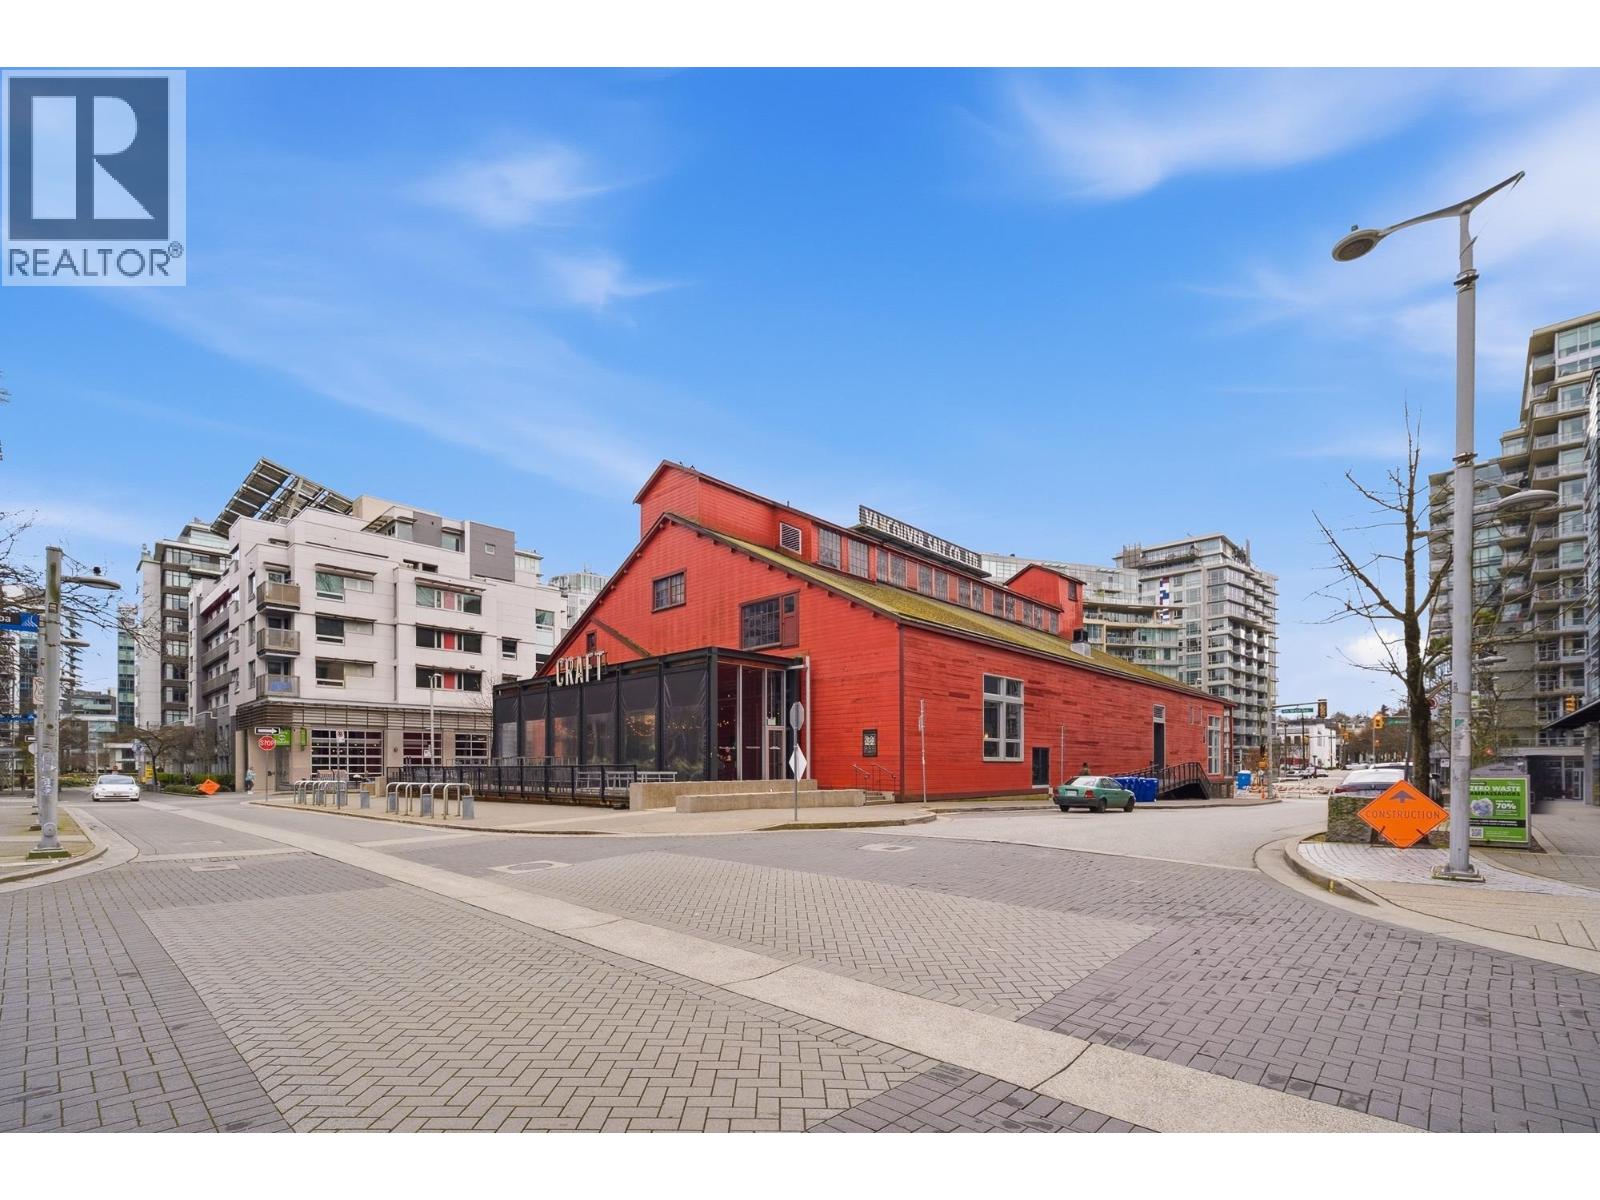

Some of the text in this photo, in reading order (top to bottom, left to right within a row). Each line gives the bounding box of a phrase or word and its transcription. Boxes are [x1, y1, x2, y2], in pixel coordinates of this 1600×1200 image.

[864, 509, 925, 546] VANCOUVER
[927, 535, 946, 555] SALT
[556, 650, 605, 687] CRAFT
[259, 739, 275, 747] STOP
[1495, 802, 1517, 810] 70%
[1365, 810, 1440, 819] CONSTRUCTION
